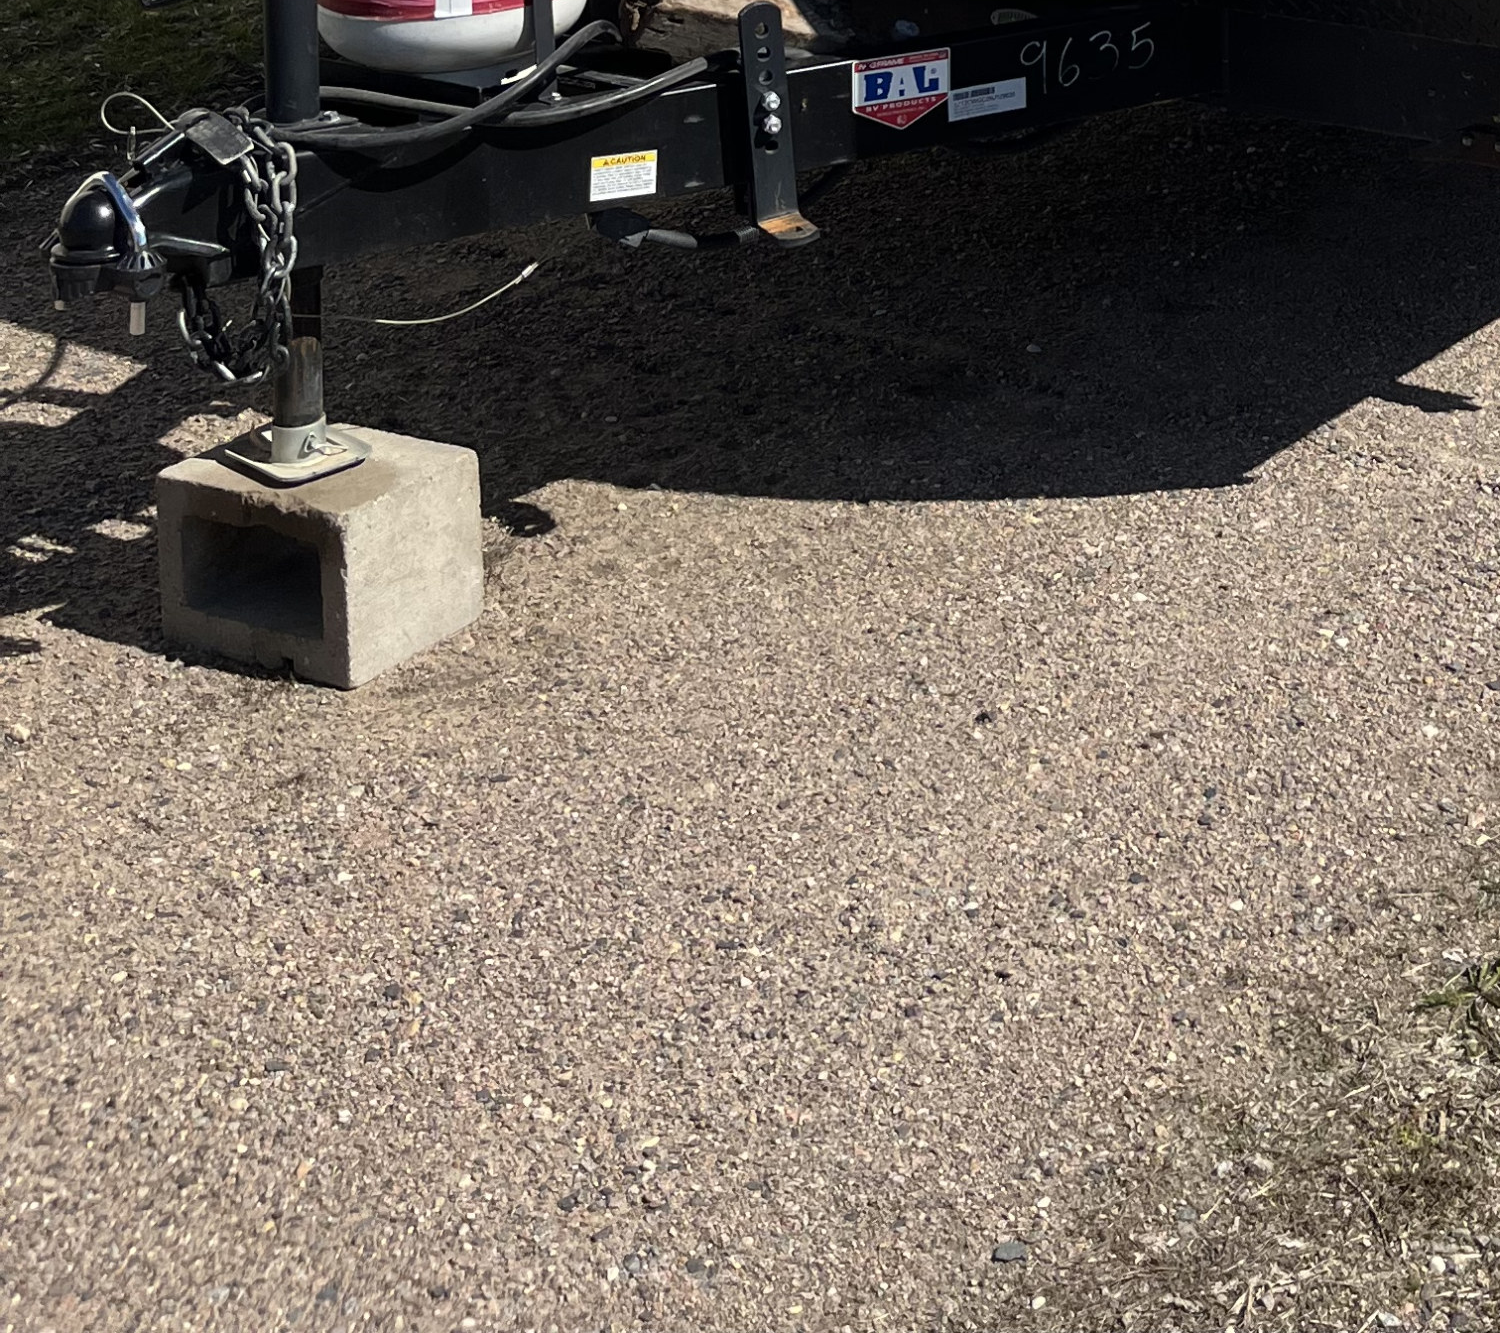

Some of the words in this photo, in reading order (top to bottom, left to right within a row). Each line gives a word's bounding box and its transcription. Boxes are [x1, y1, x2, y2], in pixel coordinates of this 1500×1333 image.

[1020, 21, 1155, 94] 9635
[864, 65, 940, 103] BAL
[882, 95, 937, 111] PRODUCTS
[610, 155, 646, 166] CAUTION
